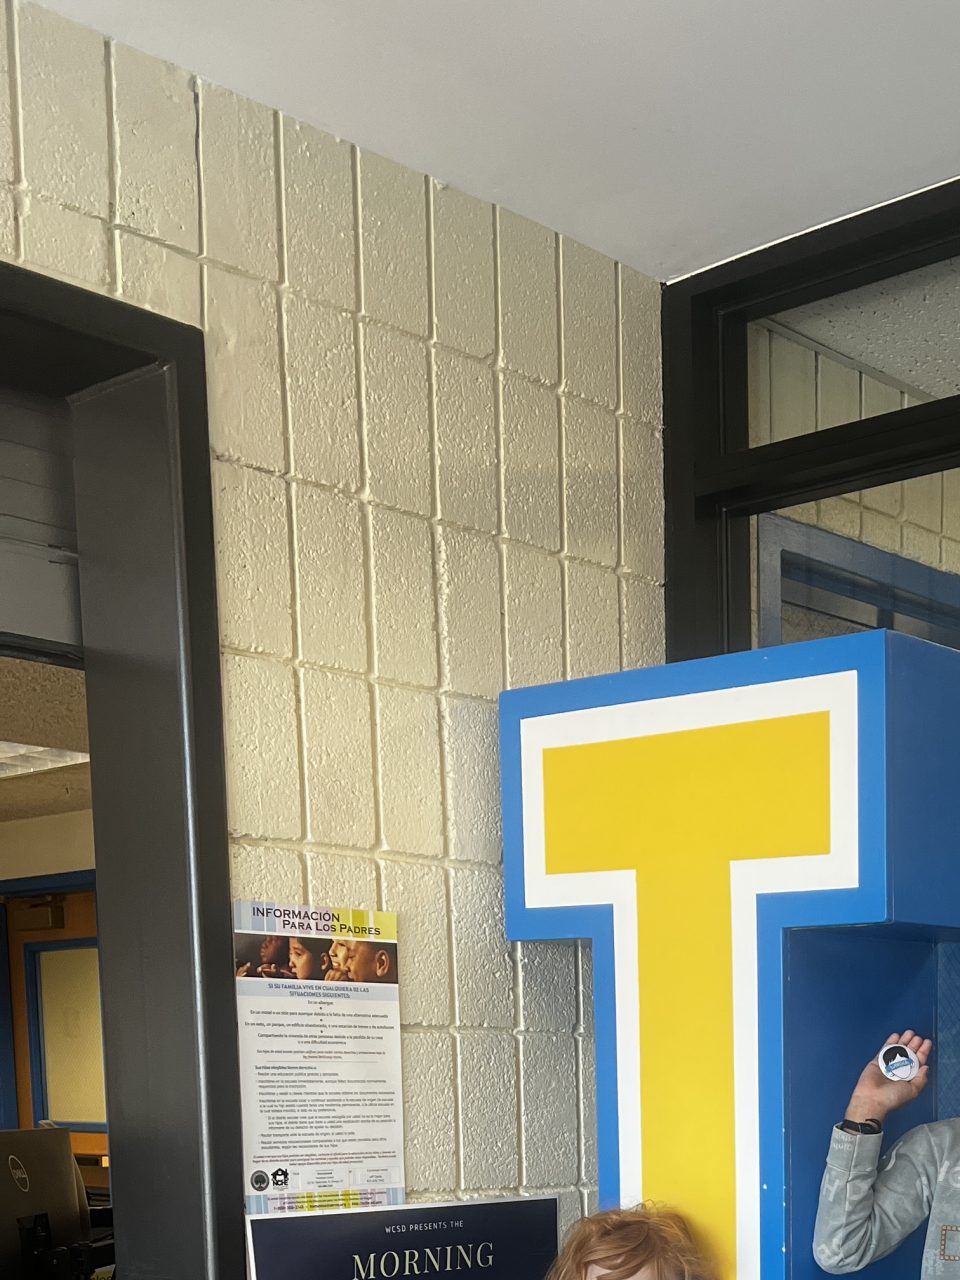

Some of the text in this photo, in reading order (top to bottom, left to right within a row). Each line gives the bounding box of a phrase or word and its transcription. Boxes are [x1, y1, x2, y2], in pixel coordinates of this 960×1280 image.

[252, 906, 340, 922] INFORMACIÓN
[282, 920, 381, 936] PARA LOS PADRES
[385, 1219, 464, 1233] WCSD PRESENTS THE
[352, 1241, 495, 1280] MORNING
